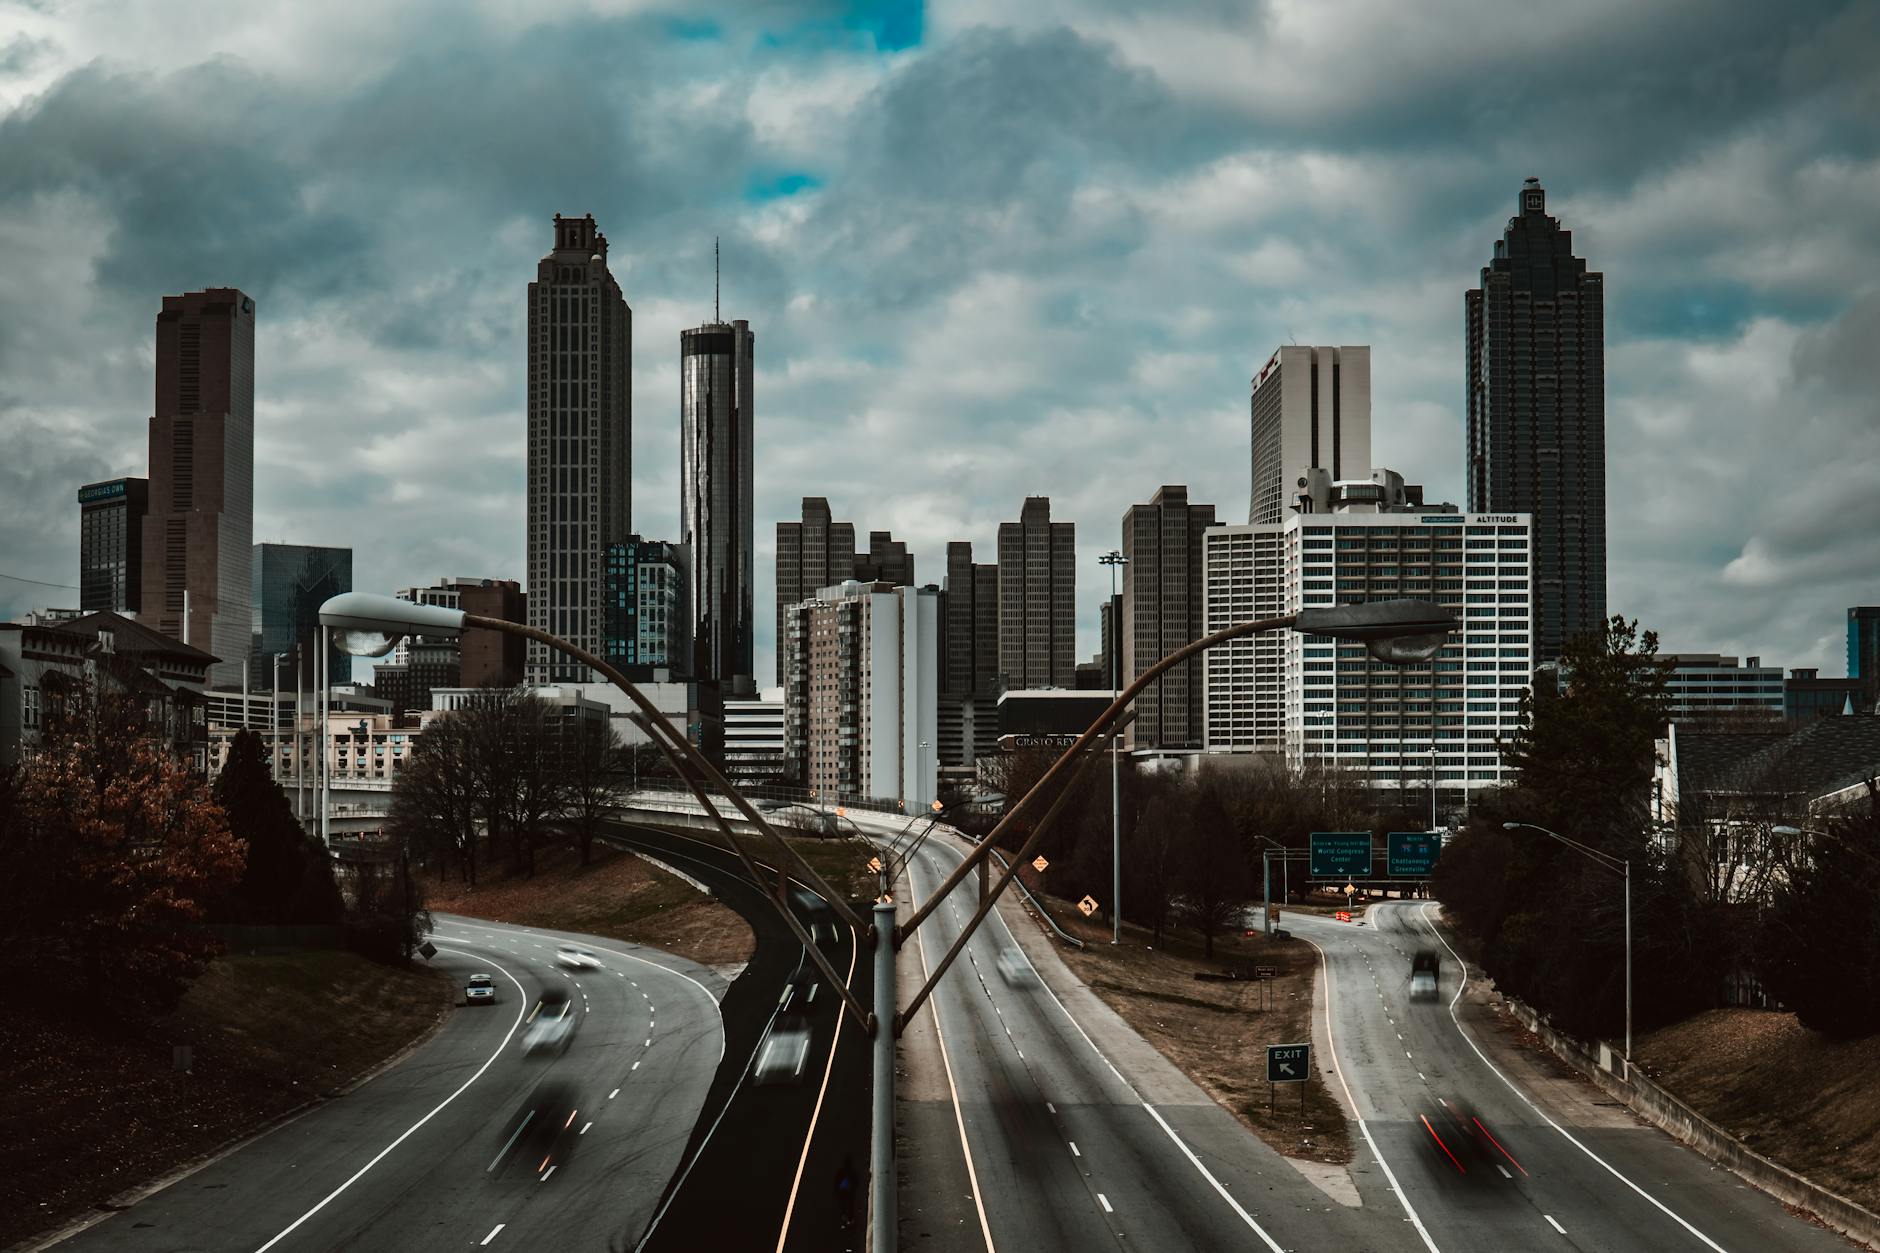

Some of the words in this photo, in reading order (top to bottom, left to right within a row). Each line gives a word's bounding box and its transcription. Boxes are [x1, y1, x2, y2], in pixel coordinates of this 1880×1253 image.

[1015, 737, 1053, 746] CRISTO
[1056, 737, 1075, 746] REY
[1274, 1050, 1302, 1059] EXIT
